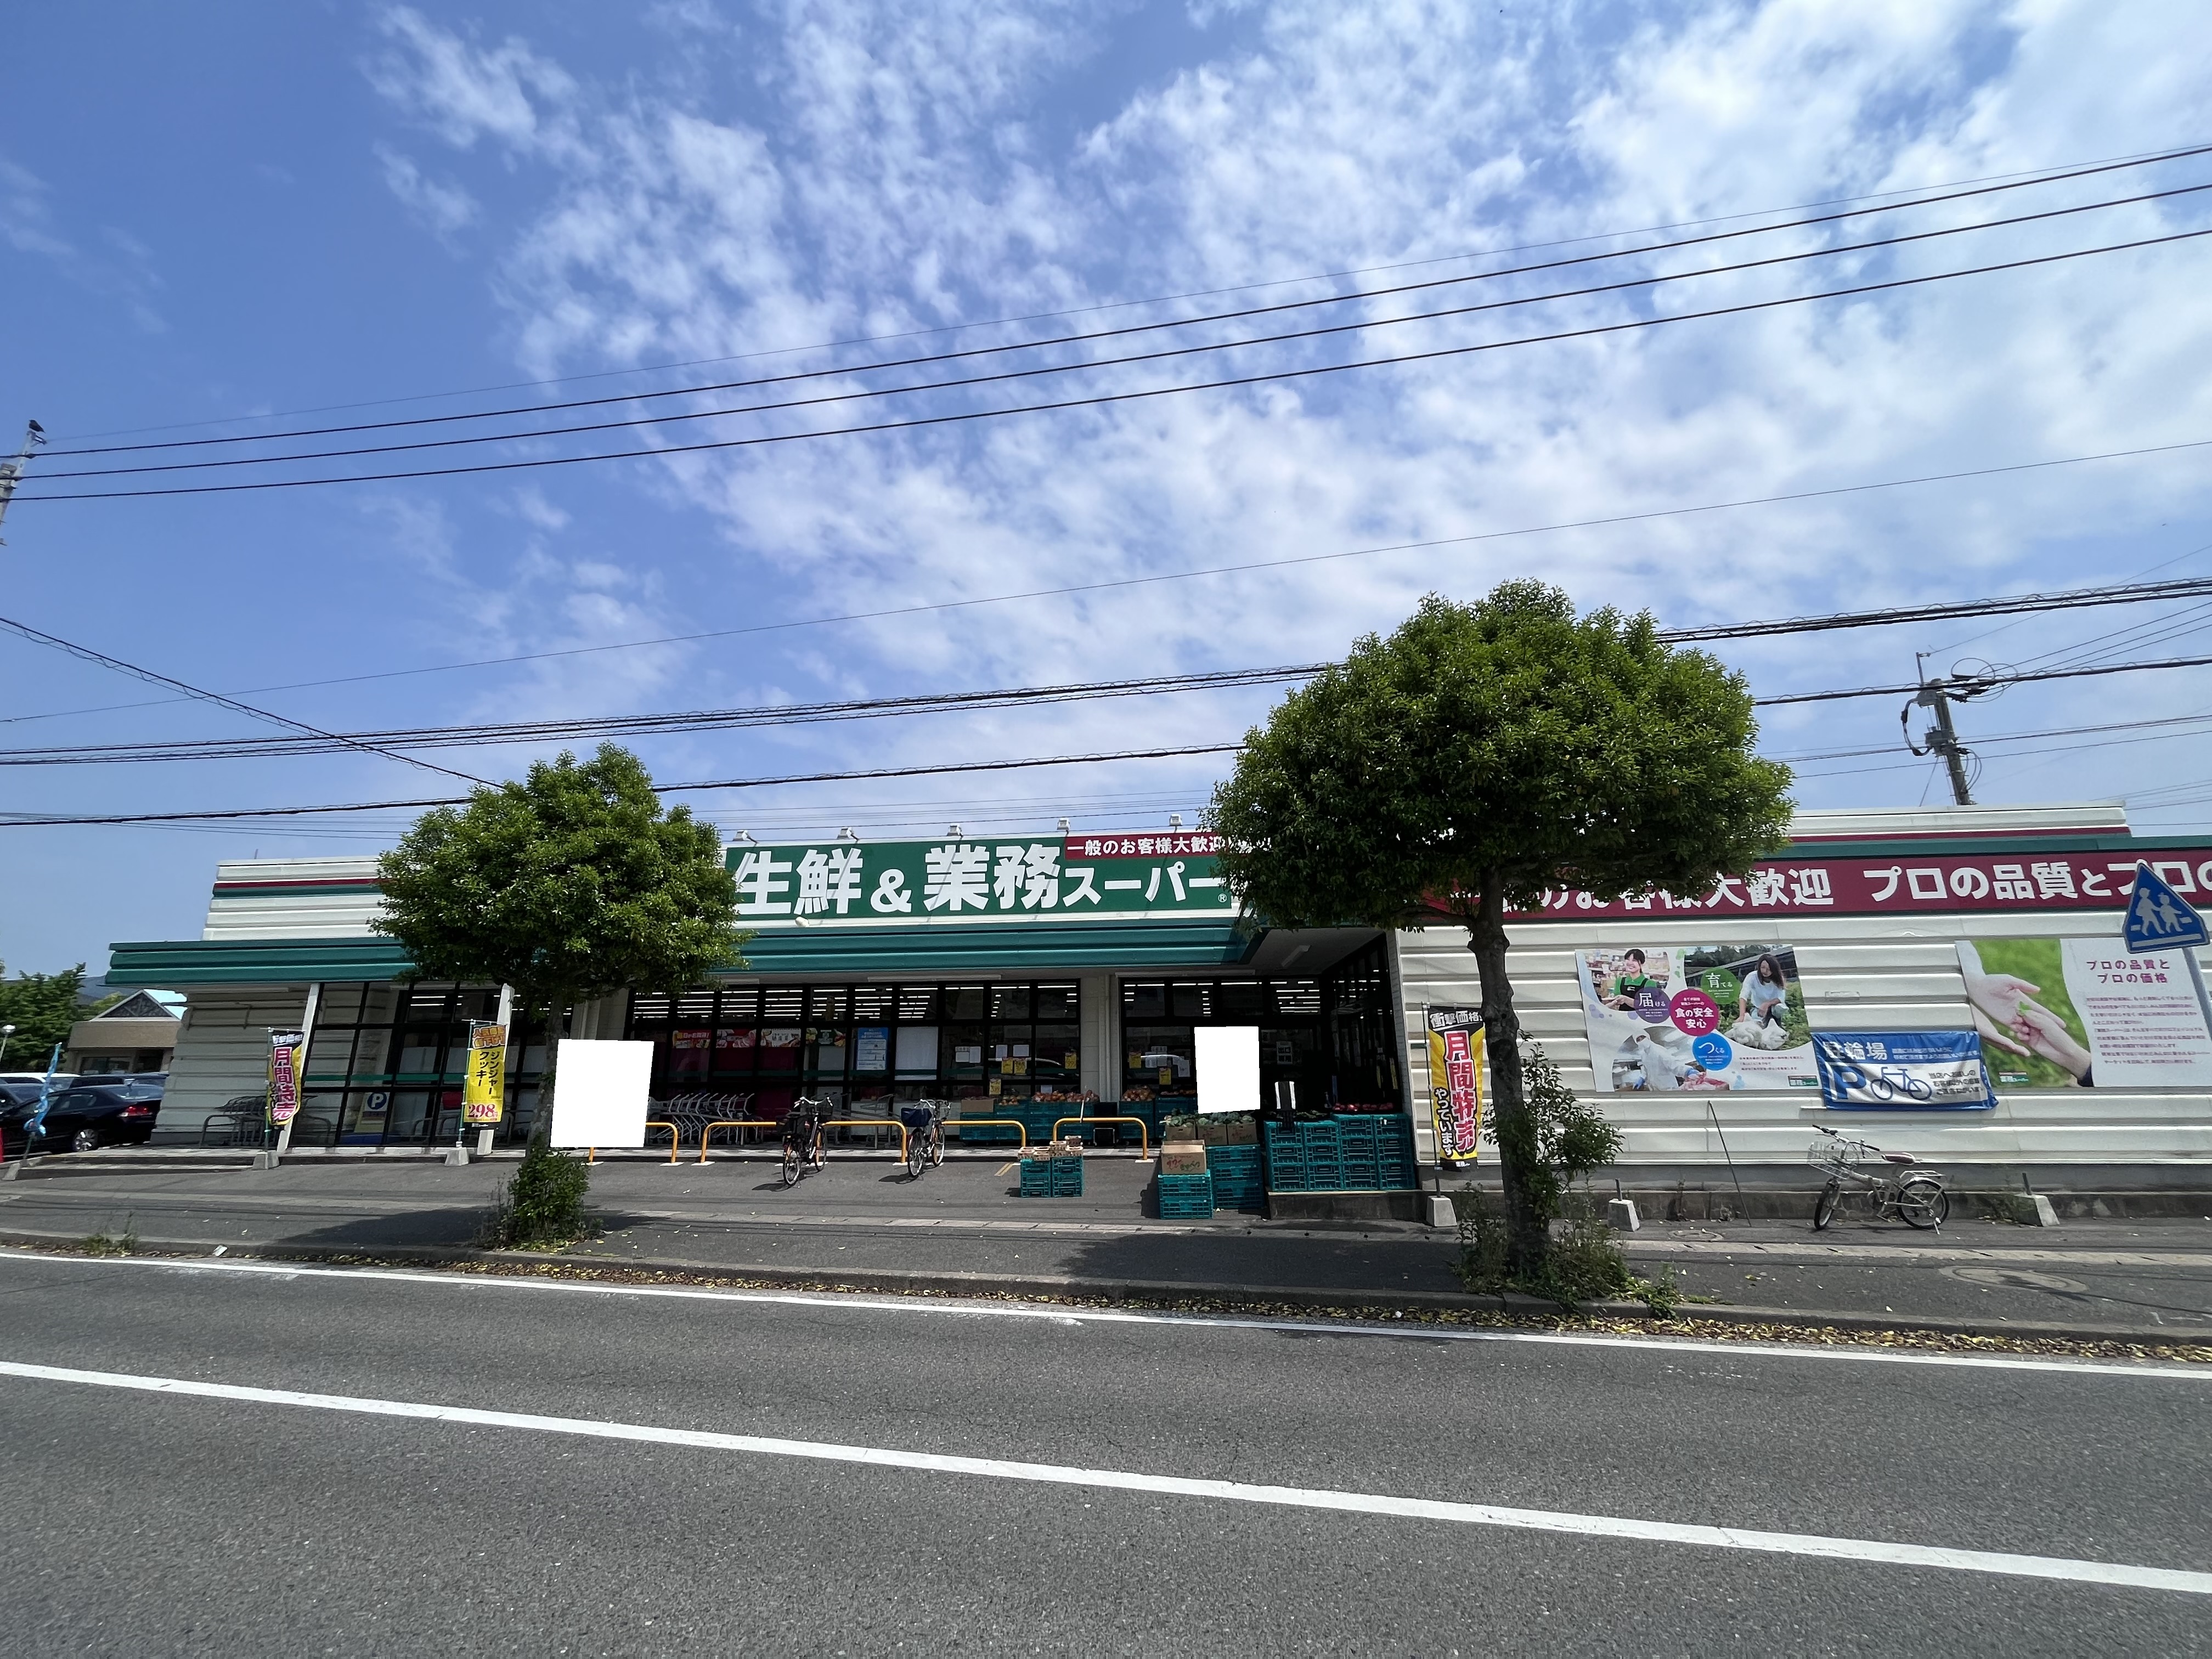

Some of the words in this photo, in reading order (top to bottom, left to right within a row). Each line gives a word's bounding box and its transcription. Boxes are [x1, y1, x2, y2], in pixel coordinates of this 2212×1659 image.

[2086, 959, 2170, 970] プロの品質と
[1705, 973, 1733, 988] 育てる
[2097, 973, 2168, 984] プロの価格
[1639, 992, 1666, 1008] 届ける
[1675, 1007, 1714, 1018] 食の安全
[1685, 1019, 1707, 1029] 安心
[1699, 1042, 1725, 1054] つくる
[476, 1051, 489, 1087] クッキー
[488, 1051, 500, 1095] ジンジャー
[1830, 1065, 1866, 1099] P
[1434, 1087, 1454, 1156] やっています
